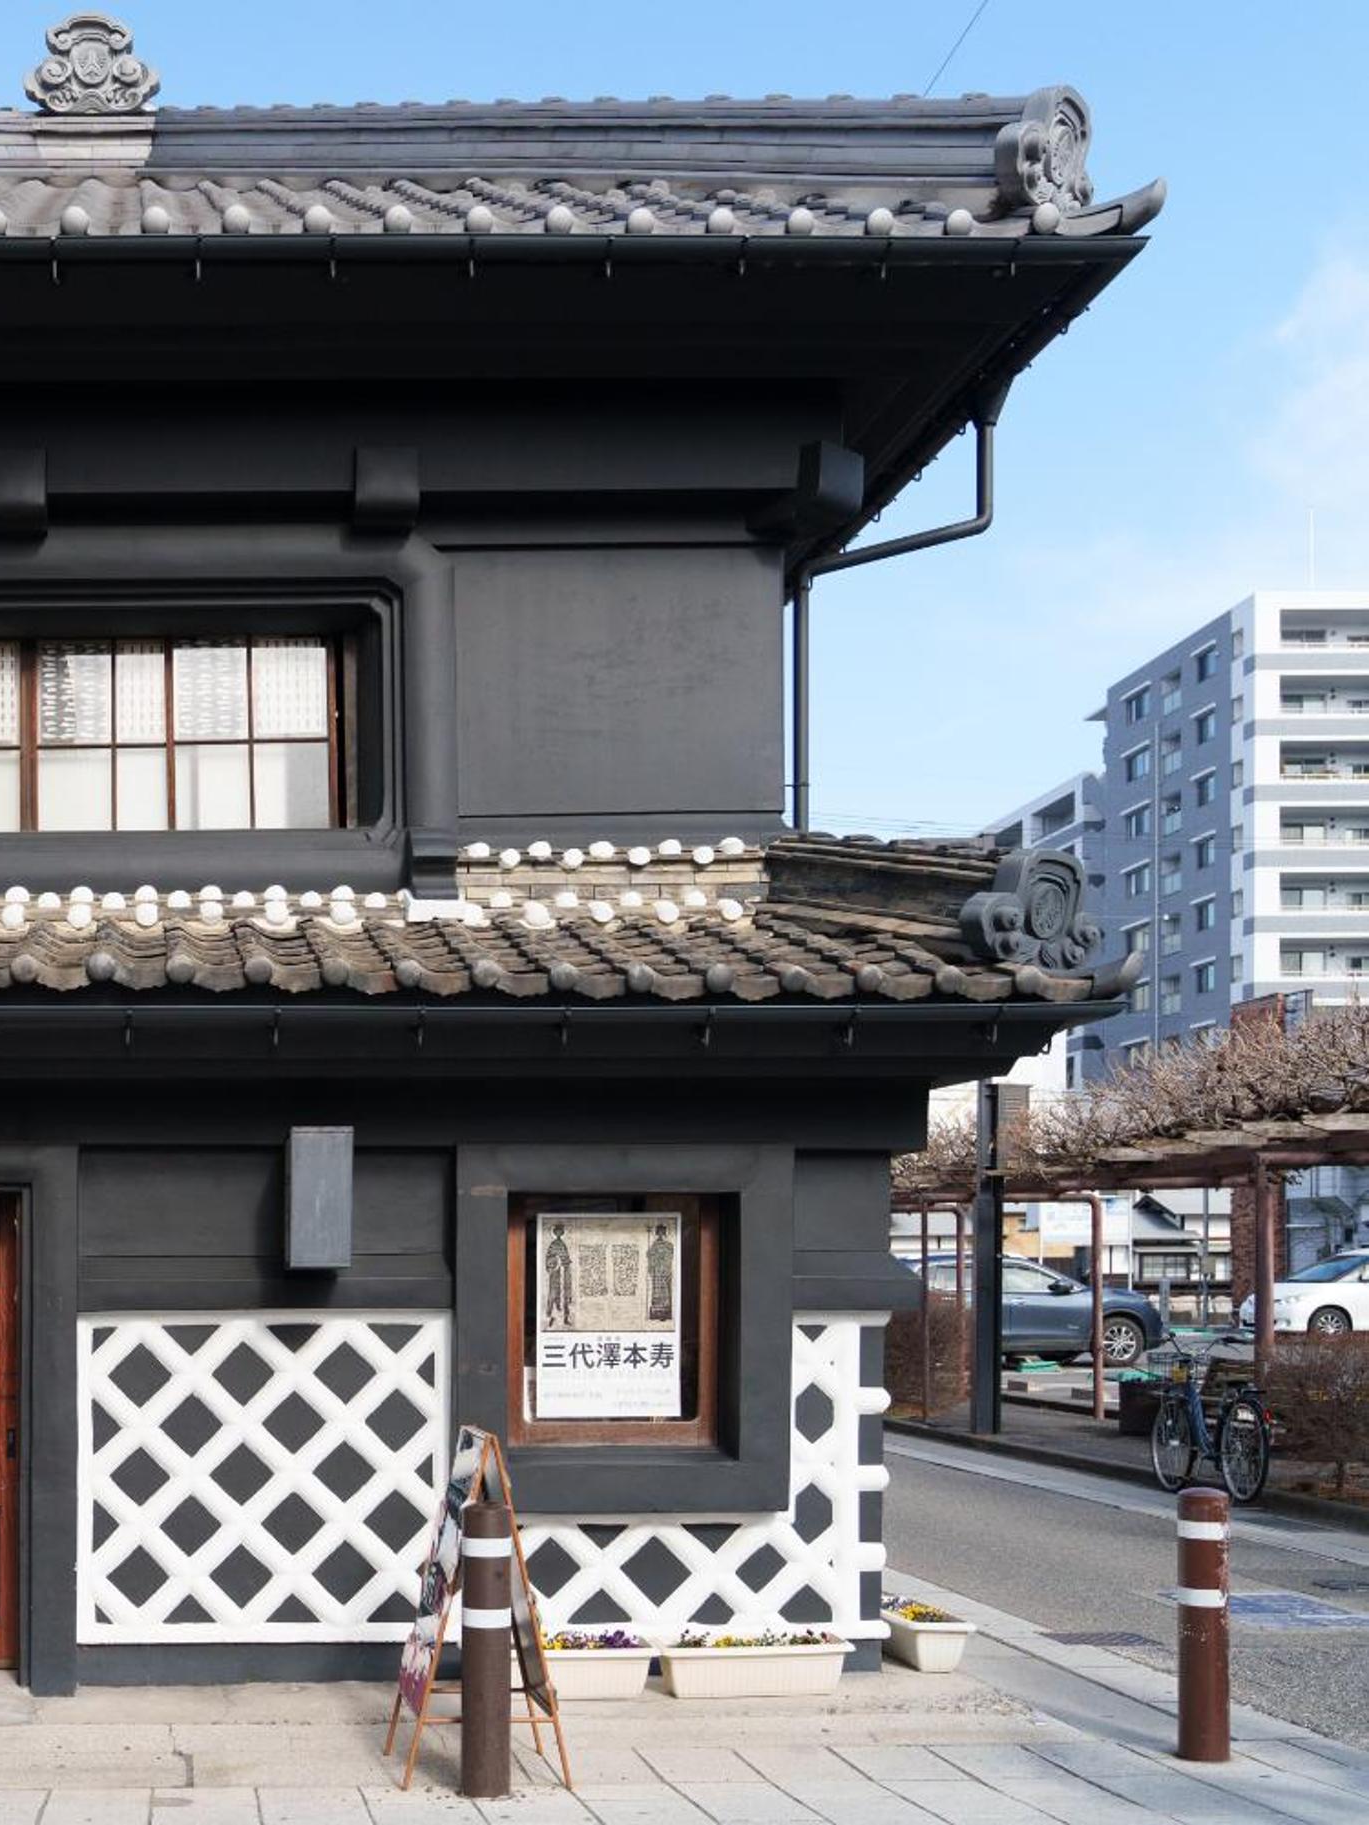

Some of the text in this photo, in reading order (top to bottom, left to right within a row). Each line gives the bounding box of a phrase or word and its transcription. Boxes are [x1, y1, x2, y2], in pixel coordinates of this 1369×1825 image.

[542, 1342, 674, 1369] 三代澤本寿
